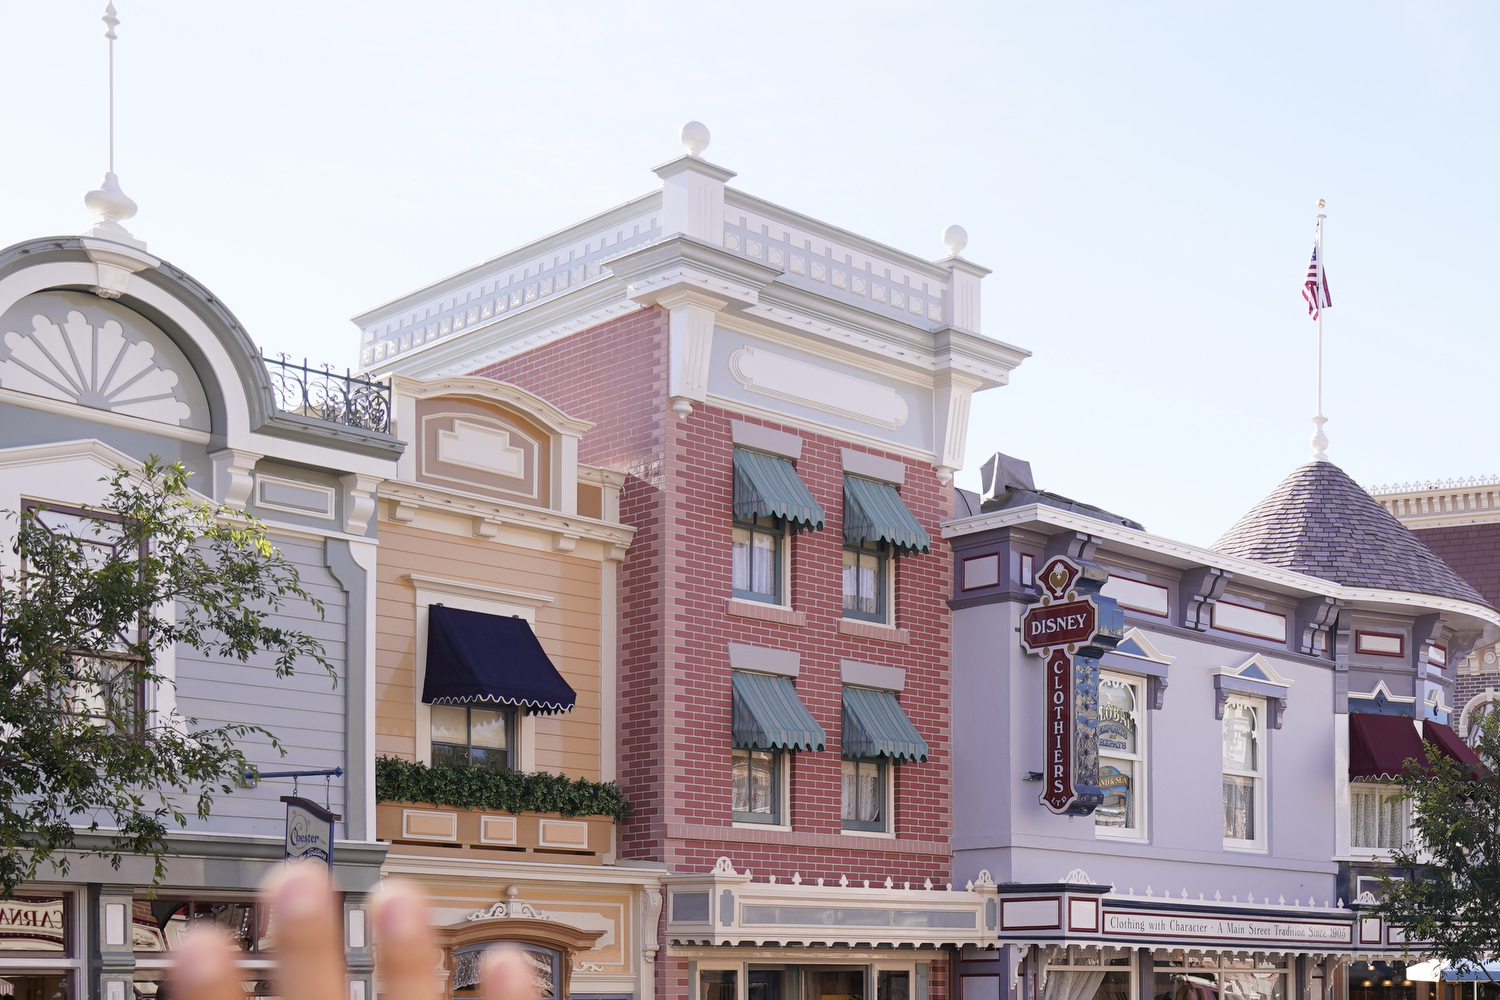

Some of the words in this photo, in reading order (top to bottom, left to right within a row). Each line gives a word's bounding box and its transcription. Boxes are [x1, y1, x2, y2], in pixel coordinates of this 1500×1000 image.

[1031, 612, 1088, 636] DISNEY
[1053, 659, 1065, 794] CLOTHIERS
[1051, 796, 1067, 806] LTD
[291, 826, 320, 846] Chester
[1110, 916, 1145, 932] Clothing
[1148, 920, 1166, 931] with
[1169, 920, 1208, 932] Character
[1217, 922, 1223, 933] A
[1226, 922, 1245, 934] Main
[1248, 924, 1271, 935] Street
[1274, 925, 1306, 937] Tradition
[1308, 926, 1327, 937] Since
[1329, 927, 1346, 939] 1905
